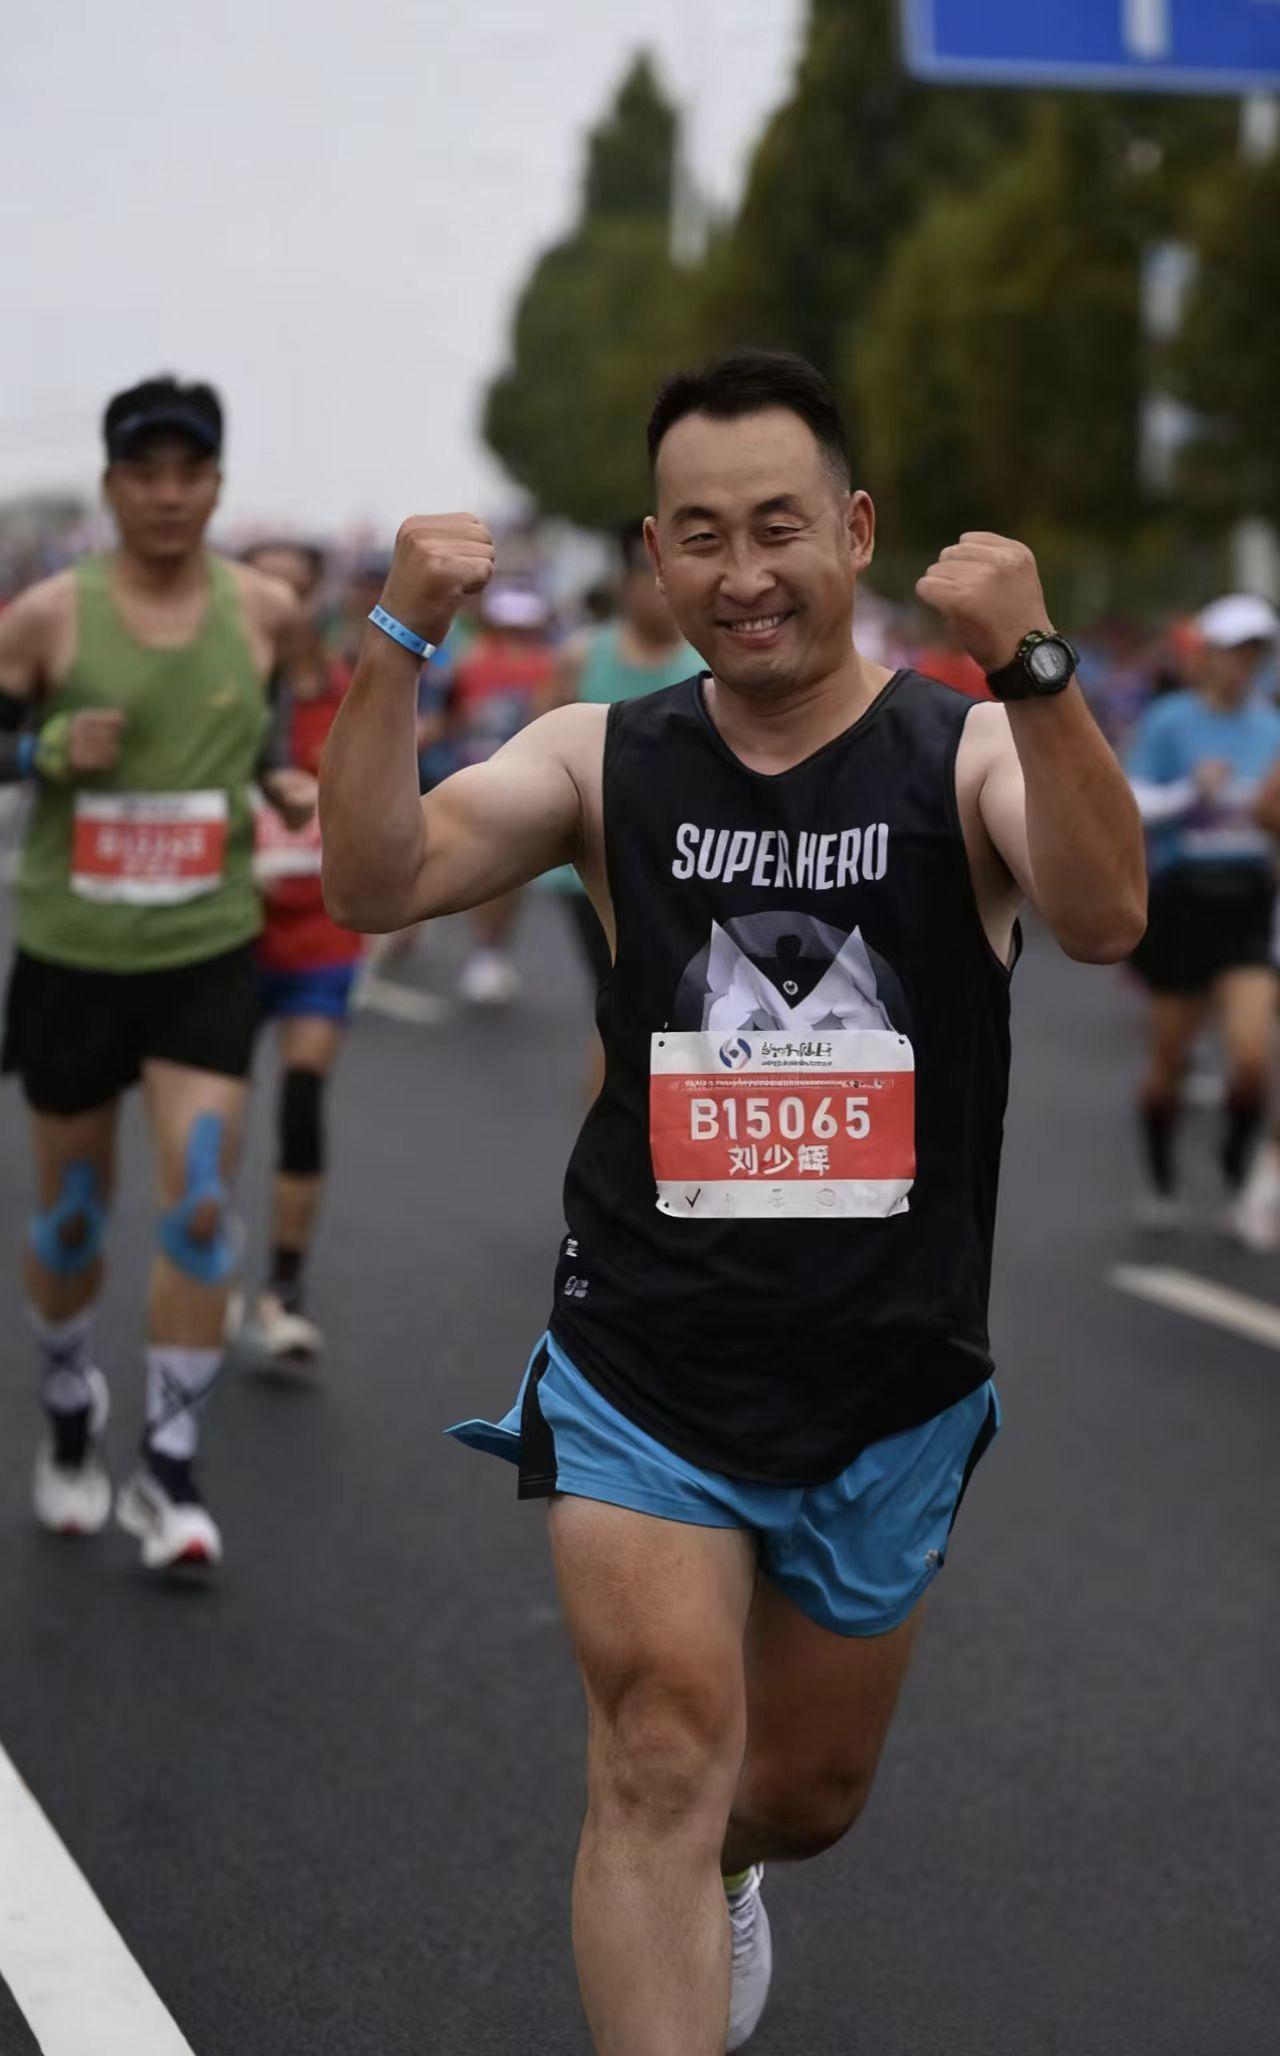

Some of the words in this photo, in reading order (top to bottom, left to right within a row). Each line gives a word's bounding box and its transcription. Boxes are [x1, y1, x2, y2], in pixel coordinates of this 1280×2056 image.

[672, 823, 793, 888] SUPER
[796, 823, 889, 890] HERO
[691, 1097, 871, 1140] B15065
